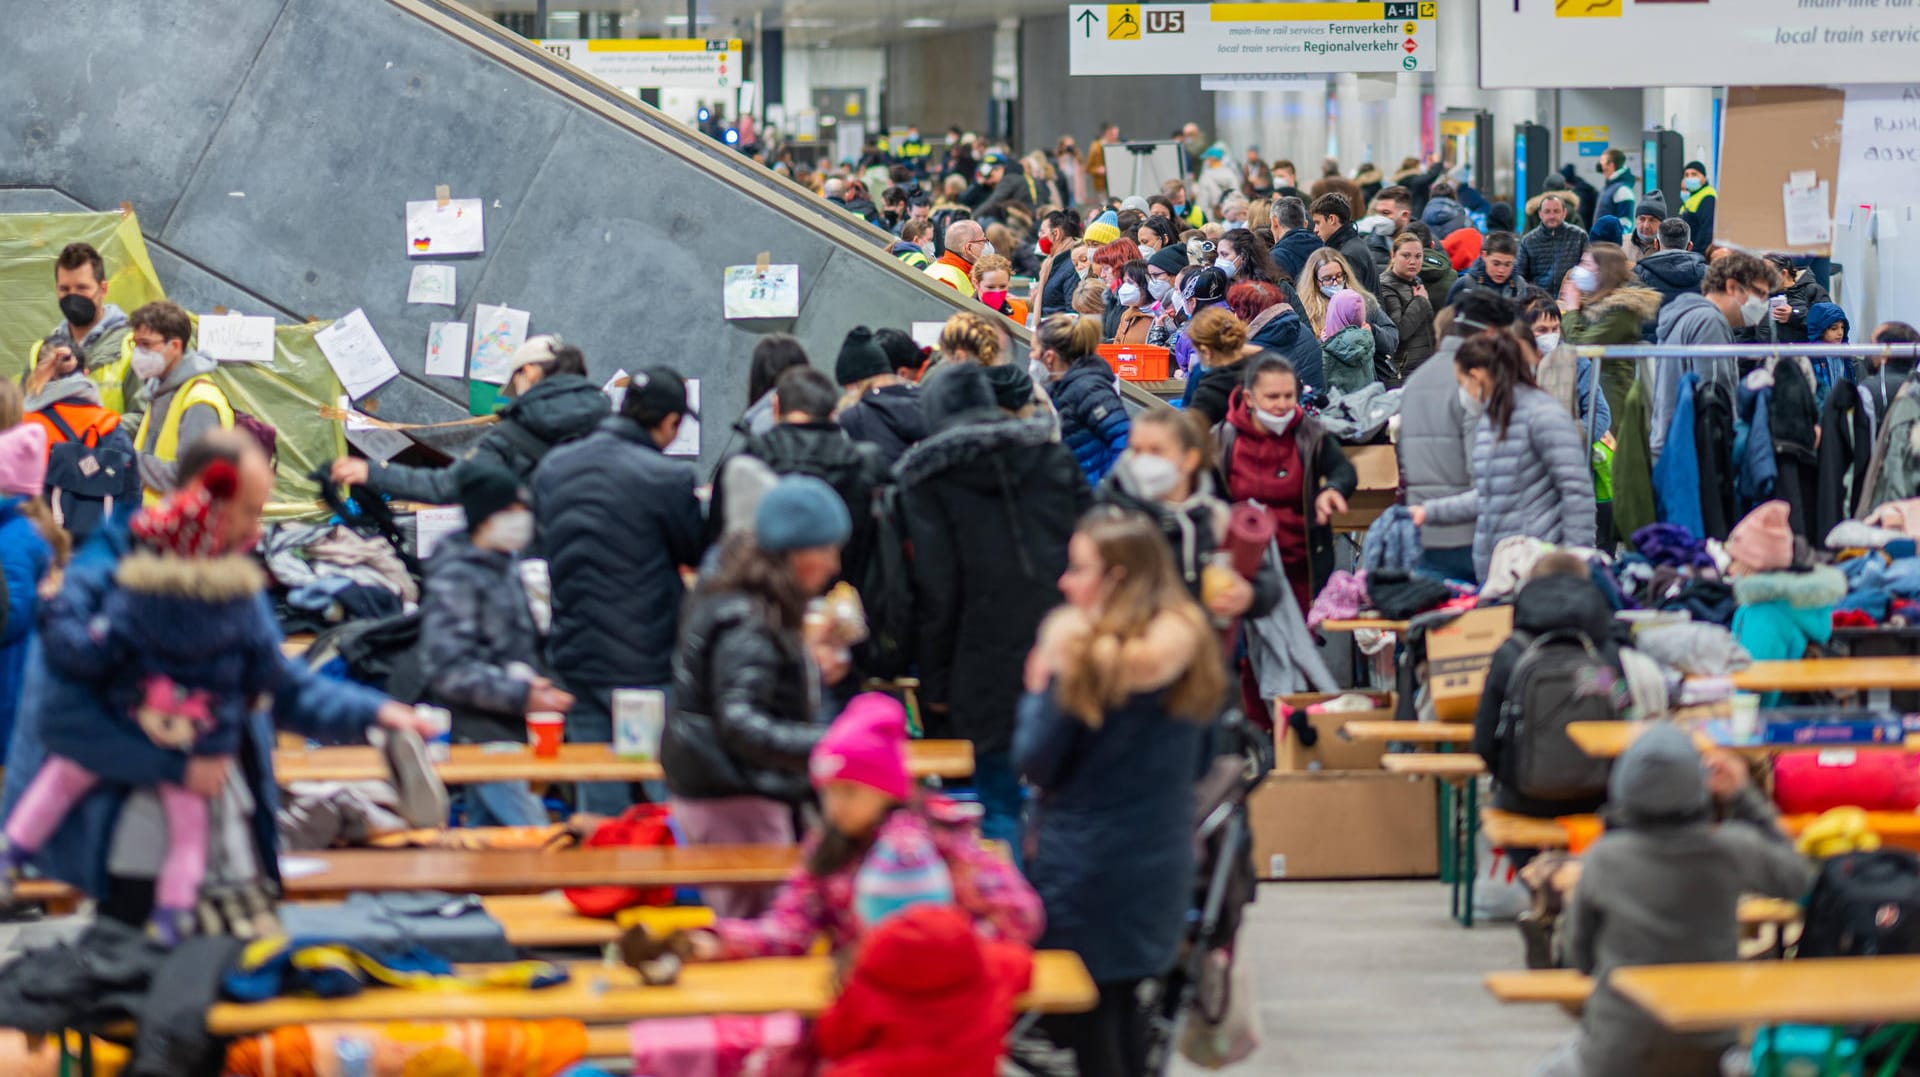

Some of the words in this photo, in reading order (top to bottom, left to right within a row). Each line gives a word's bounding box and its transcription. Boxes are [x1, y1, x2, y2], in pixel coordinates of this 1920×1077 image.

[1387, 4, 1415, 17] A-H
[1150, 12, 1181, 32] U5
[1228, 25, 1271, 36] main-line
[1272, 25, 1288, 36] rail
[1289, 26, 1326, 36] services
[1328, 22, 1399, 35] Fernverkehr
[1775, 26, 1818, 44] local
[1823, 26, 1863, 44] train
[1217, 43, 1240, 54] local
[1241, 43, 1264, 53] train
[1265, 43, 1302, 53] services
[1303, 40, 1399, 55] Regionalverkehr
